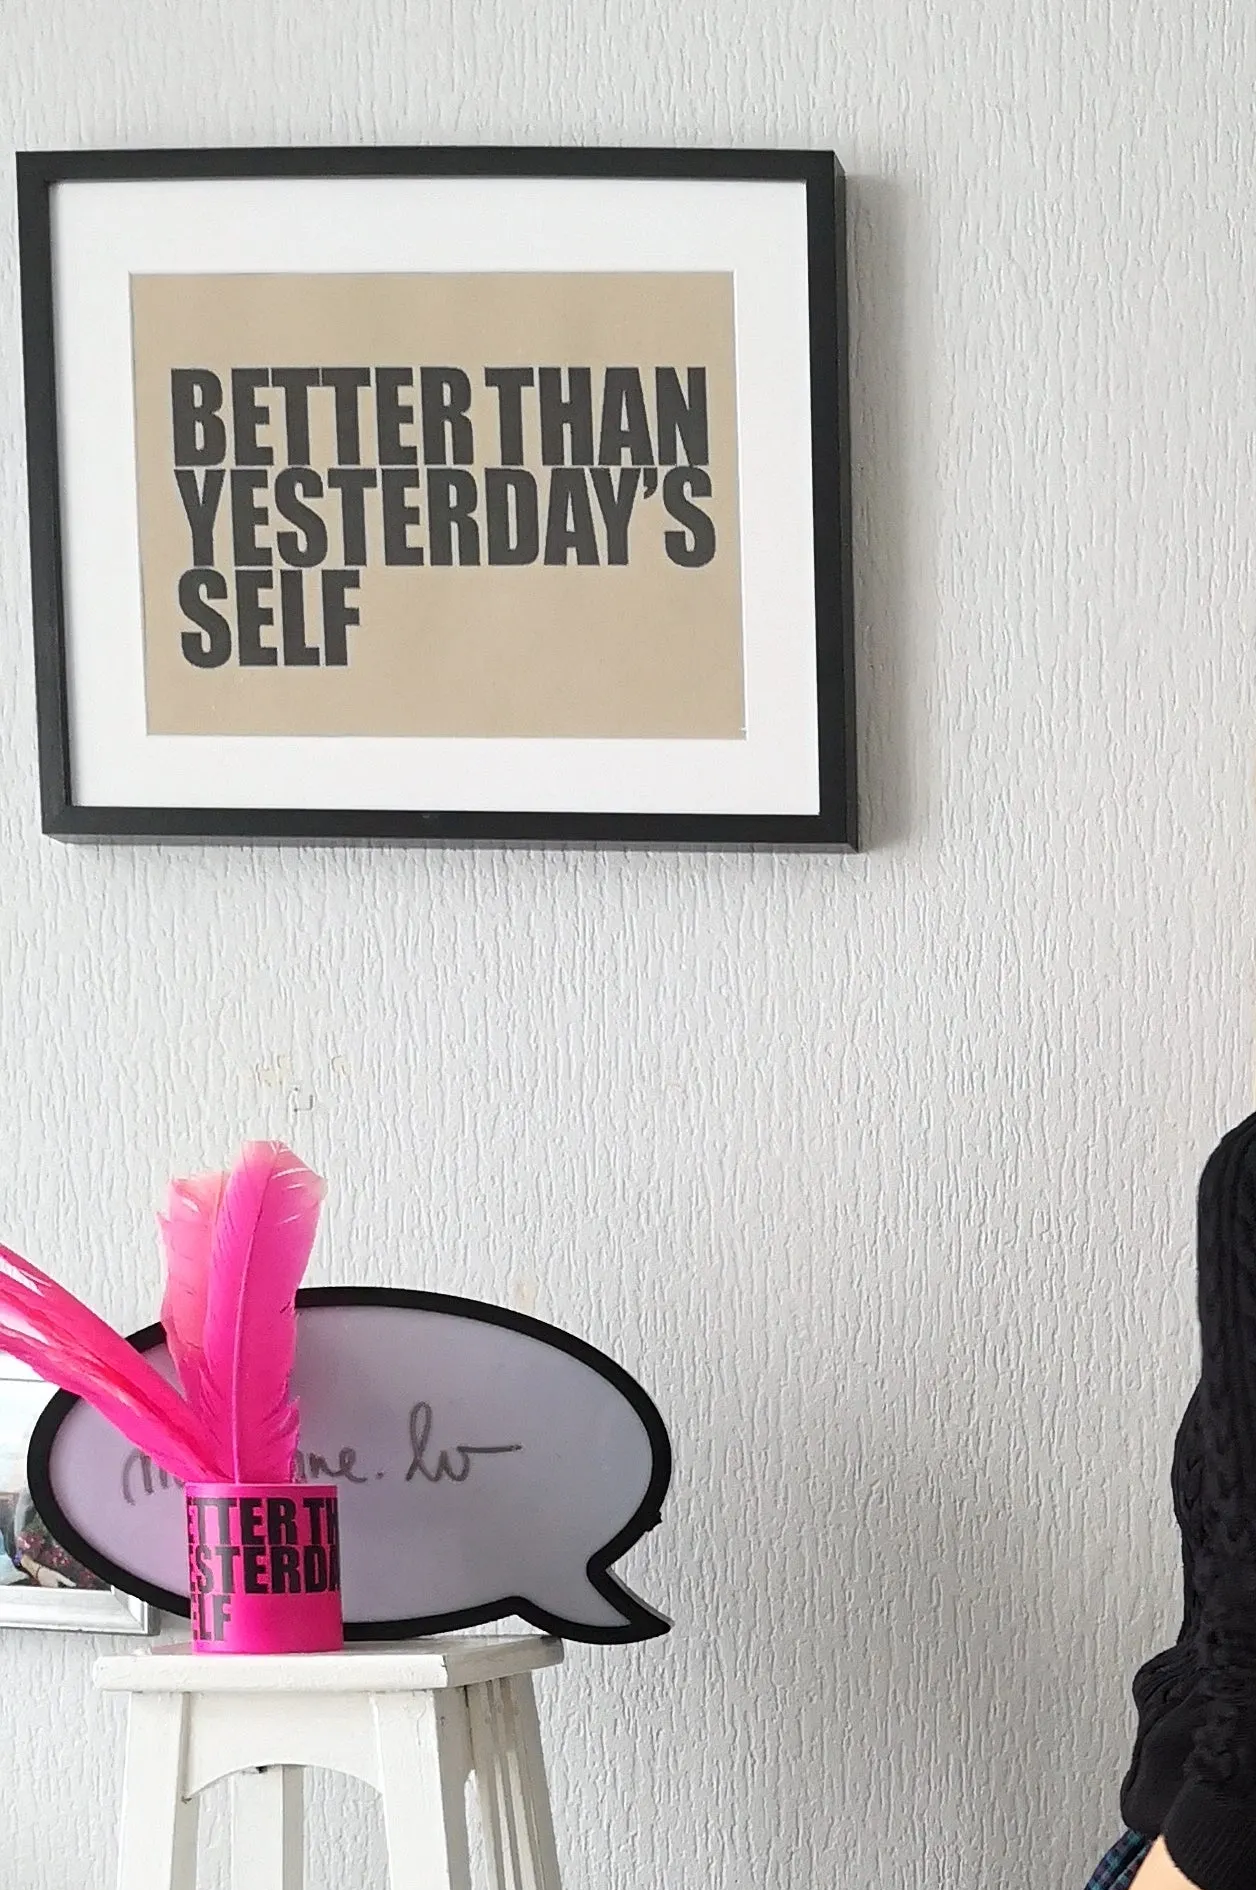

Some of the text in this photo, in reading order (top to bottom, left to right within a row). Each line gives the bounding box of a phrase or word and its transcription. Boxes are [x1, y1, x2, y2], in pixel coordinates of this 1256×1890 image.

[171, 366, 710, 467] BETTER THAN
[174, 466, 717, 567] YESTERDAY'S
[178, 568, 361, 669] SELF
